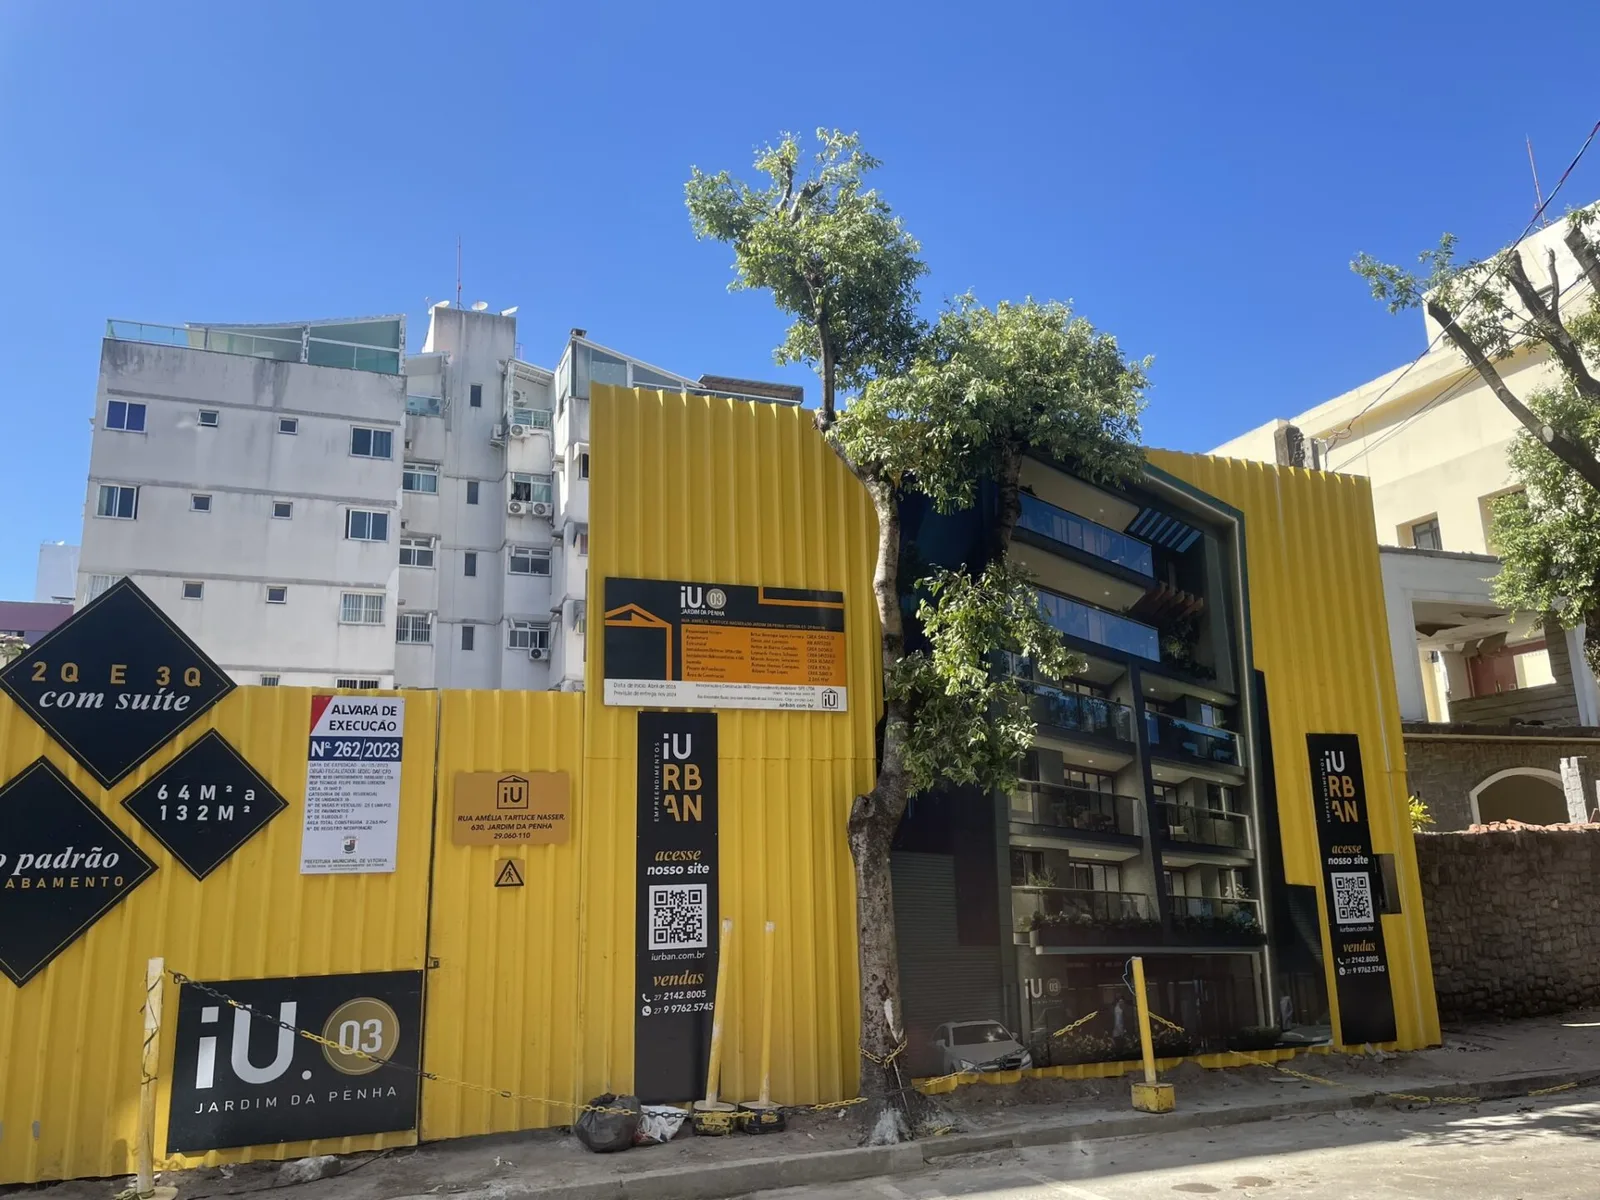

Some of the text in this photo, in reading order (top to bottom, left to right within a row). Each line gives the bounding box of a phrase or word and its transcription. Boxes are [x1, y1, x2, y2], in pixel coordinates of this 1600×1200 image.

[710, 592, 722, 605] 03
[110, 664, 127, 684] E
[39, 688, 191, 711] com suíte
[824, 694, 836, 707] iU
[331, 704, 397, 716] ALVARÁ DE
[329, 720, 396, 732] EXECUÇÃO
[333, 739, 400, 760] 262/2023
[664, 733, 692, 760] iU
[1325, 750, 1345, 772] iU
[663, 764, 702, 791] RB
[245, 789, 255, 800] a
[1328, 776, 1355, 797] RB
[503, 787, 522, 803] iU
[664, 794, 702, 822] AN
[1331, 800, 1358, 822] AN
[655, 849, 701, 862] acesse
[1332, 844, 1361, 854] acesse
[11, 846, 120, 876] padrão
[1328, 855, 1368, 865] nosso site
[647, 862, 710, 875] nosso site
[1343, 940, 1375, 952] vendas
[651, 951, 705, 961] iurban.com.br
[653, 970, 705, 986] vendas
[664, 990, 706, 1000] 2142.8005
[664, 1005, 669, 1014] 9
[671, 1002, 714, 1013] 9762.5745
[339, 1018, 383, 1055] 03
[195, 1086, 397, 1114] JARDIM DA PENHA
